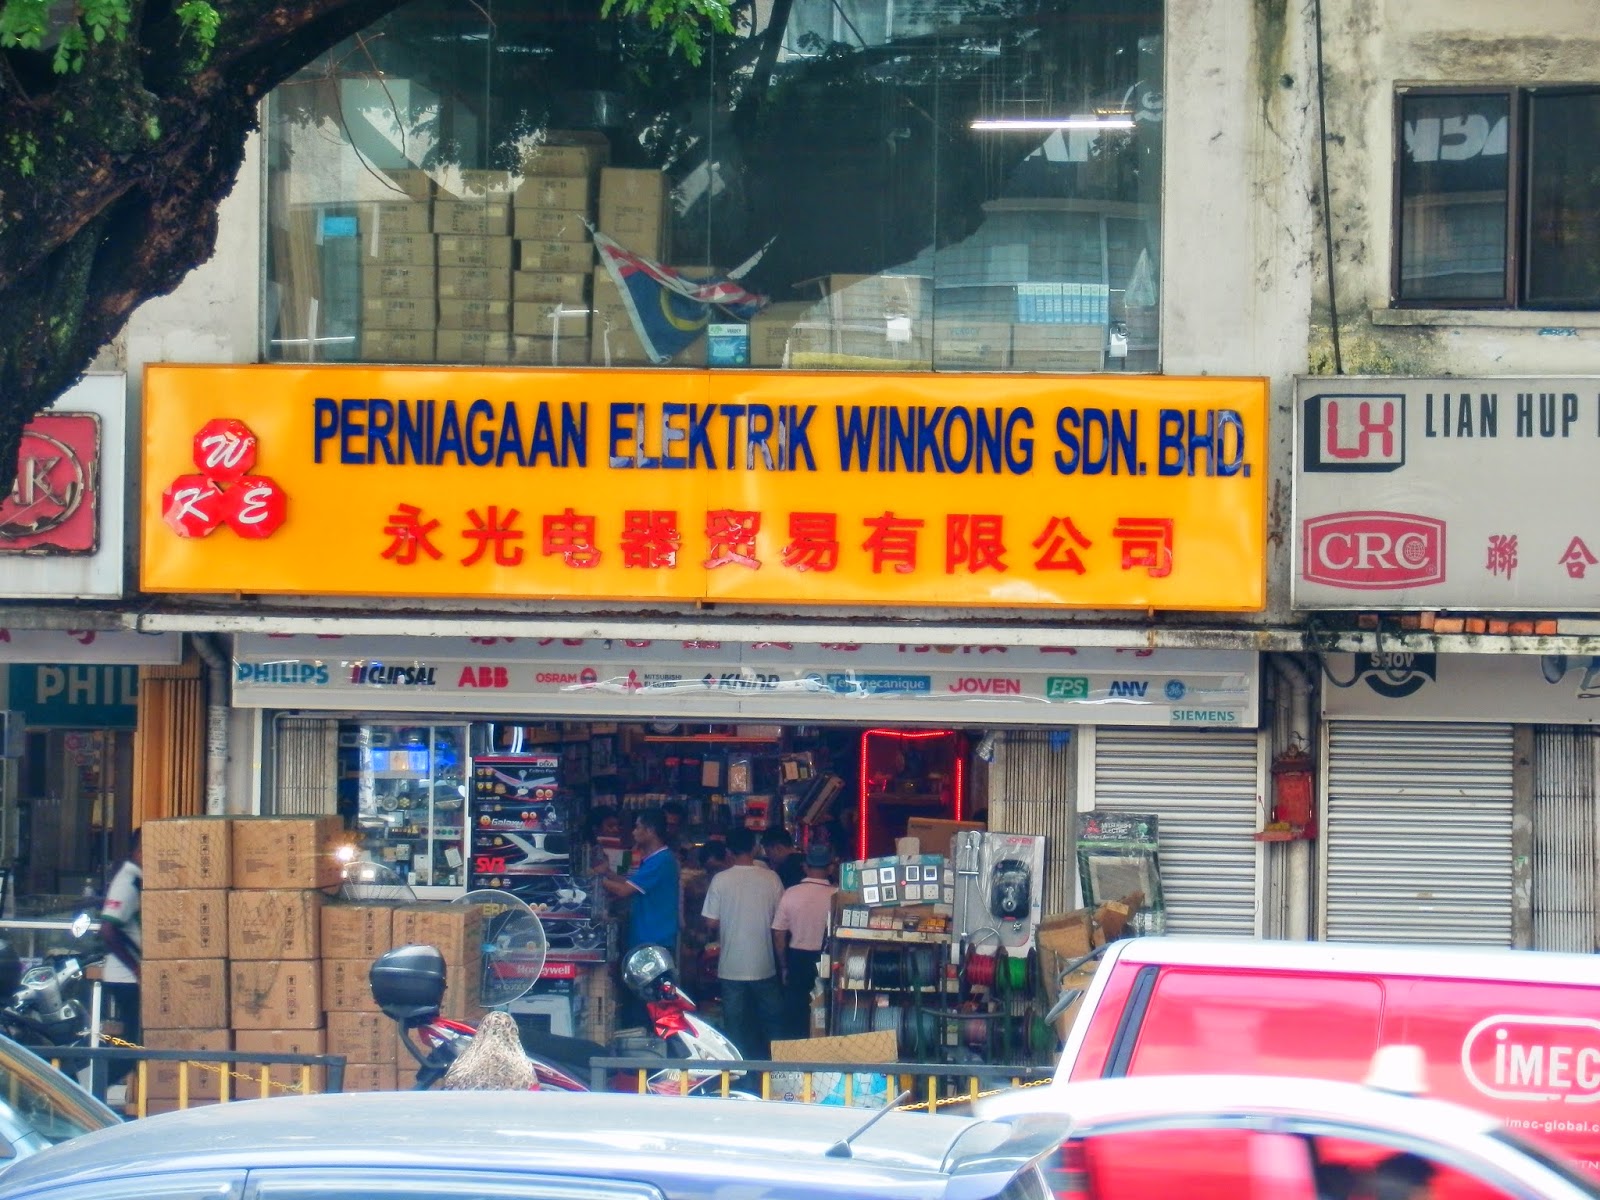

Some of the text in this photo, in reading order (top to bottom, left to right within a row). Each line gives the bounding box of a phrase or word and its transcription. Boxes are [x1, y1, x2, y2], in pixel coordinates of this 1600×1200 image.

[1425, 393, 1498, 438] LIAN
[1516, 393, 1579, 438] HUP
[313, 397, 1251, 478] PERNIAGAAN ELEKTRIK WINKONG SDN. BHD.
[380, 503, 1174, 578] 永光电器贸易有限公司
[1318, 532, 1429, 571] CRC
[237, 662, 329, 685] PHILIPS
[368, 665, 437, 686] CLIPSAL
[458, 666, 508, 688] ABB
[536, 673, 577, 683] OSRAM
[643, 673, 682, 681] MITSUBISHI
[949, 678, 1021, 694] JOVEN
[1050, 679, 1085, 696] EPS
[1172, 710, 1235, 721] SIEMENS
[516, 964, 571, 976] Honeywell
